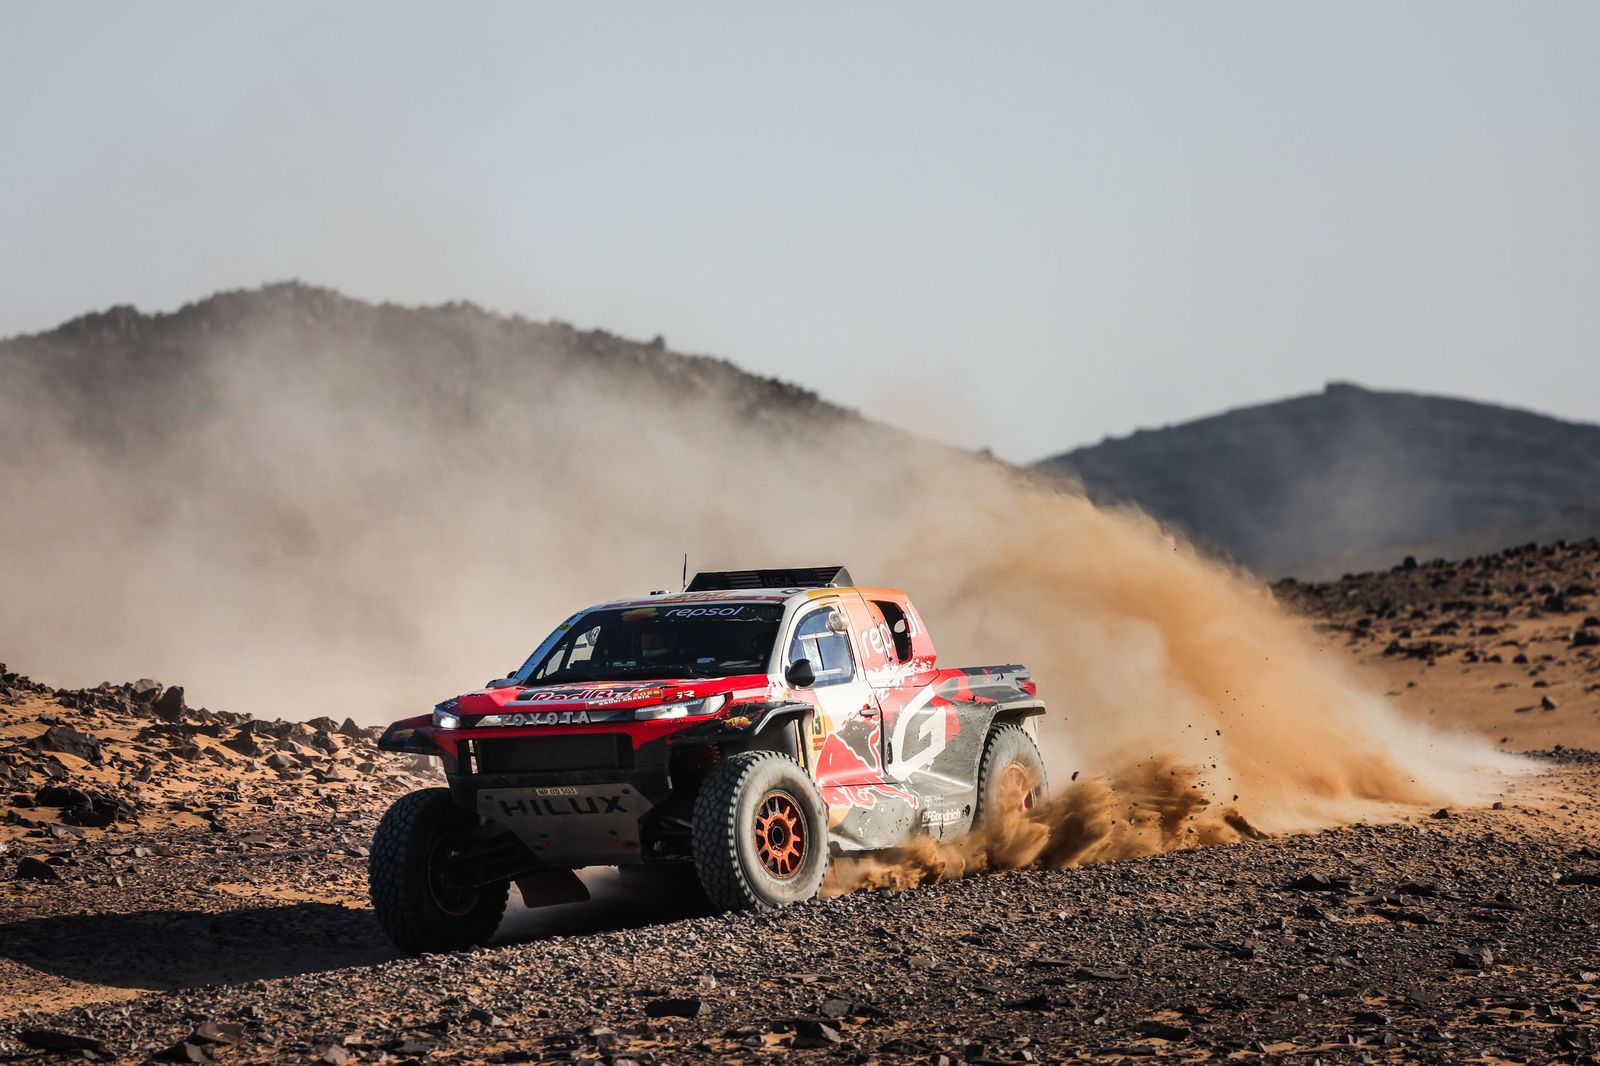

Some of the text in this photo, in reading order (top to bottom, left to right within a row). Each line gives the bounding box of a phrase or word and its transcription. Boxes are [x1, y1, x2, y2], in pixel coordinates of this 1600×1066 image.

[761, 576, 796, 588] USA
[664, 606, 744, 618] repsol
[861, 602, 922, 658] repol
[598, 698, 621, 706] SAUDI
[622, 694, 650, 702] ARABIA
[498, 711, 590, 727] TOYOTA
[499, 795, 629, 817] HILUX
